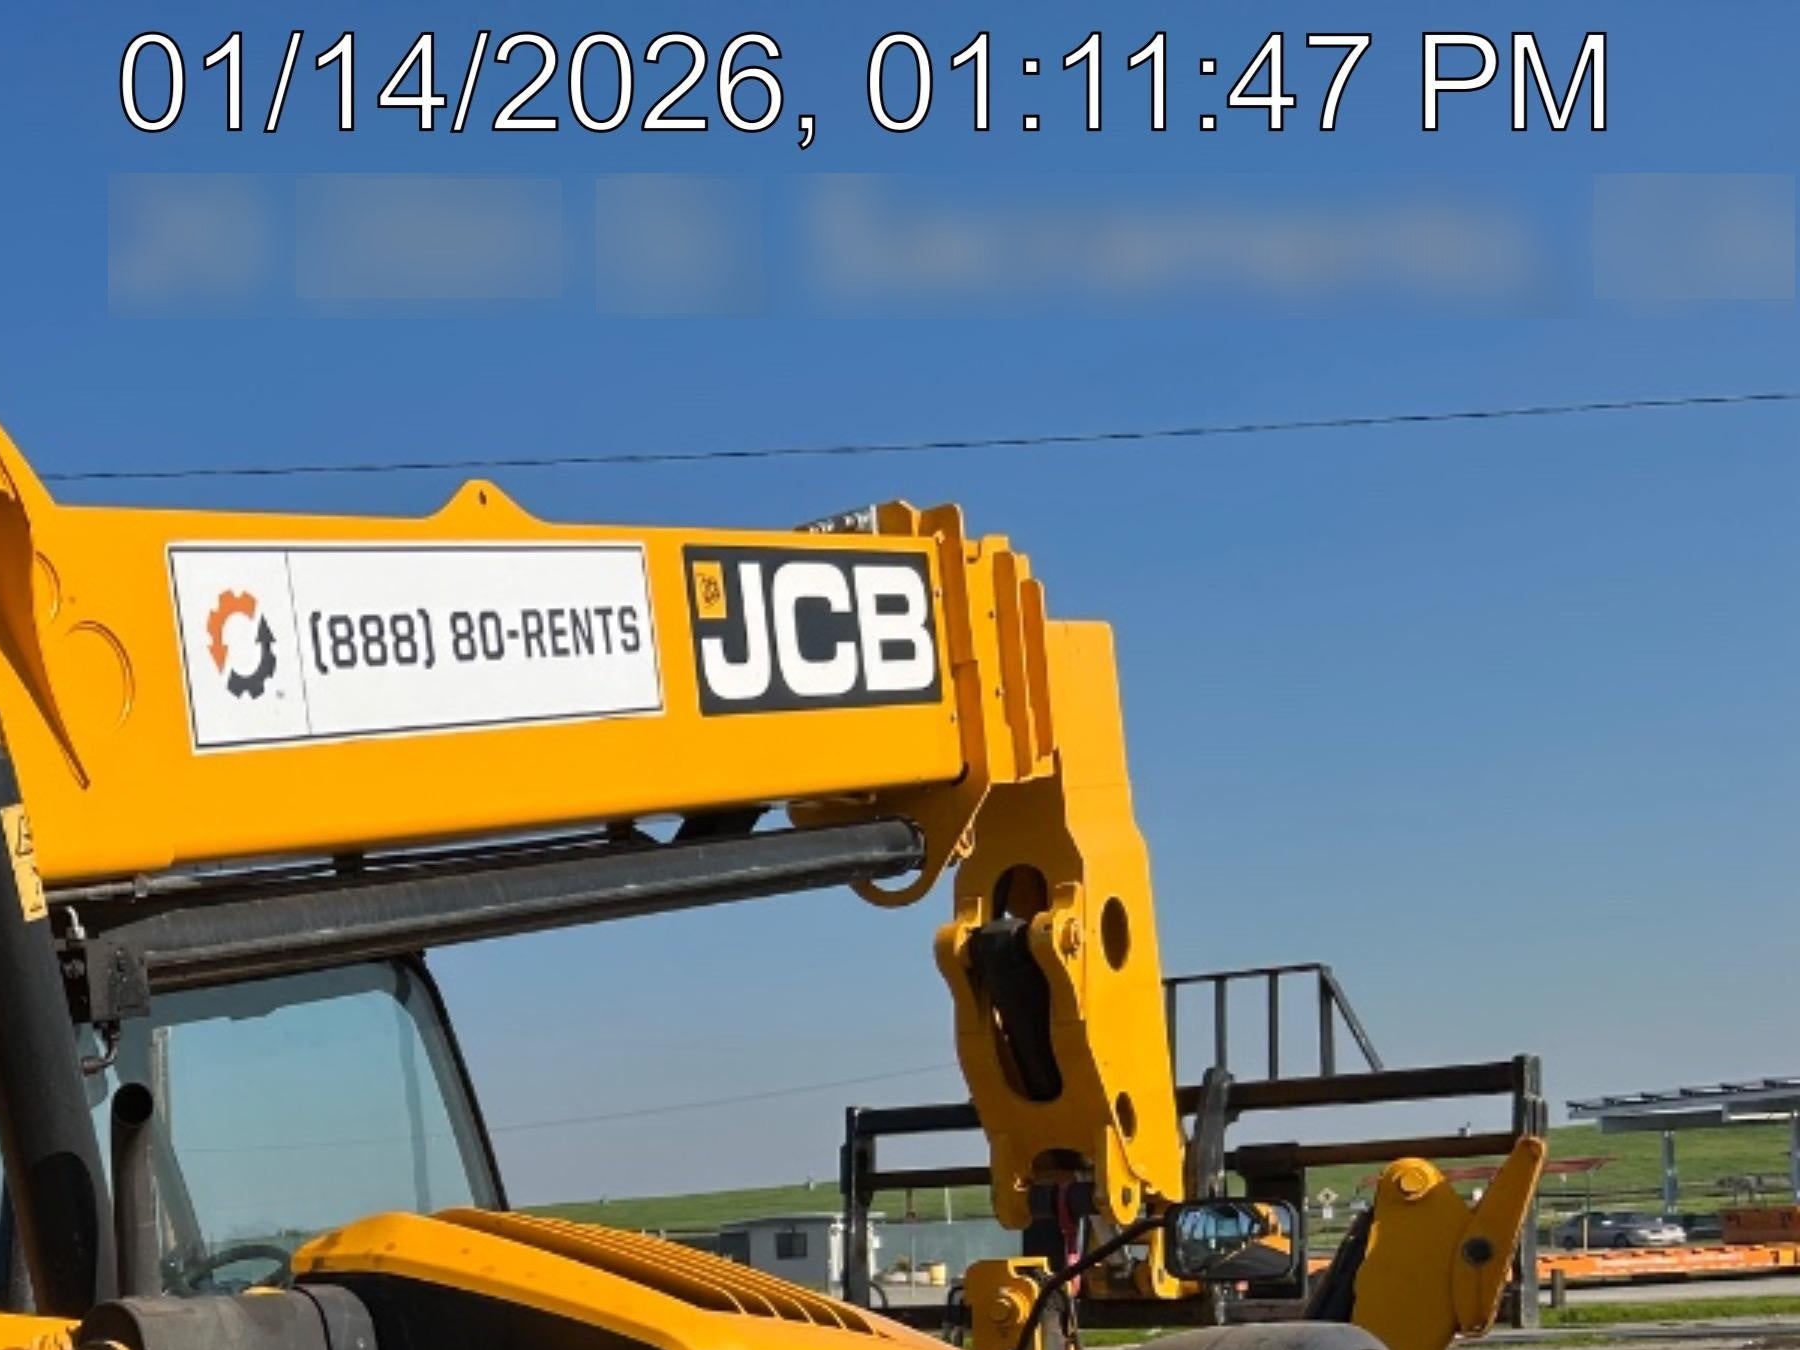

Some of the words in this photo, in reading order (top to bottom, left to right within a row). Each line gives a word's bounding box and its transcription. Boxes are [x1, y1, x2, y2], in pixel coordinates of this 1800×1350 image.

[309, 608, 435, 674] (888)
[449, 606, 641, 662] 80-RENTS
[700, 561, 936, 700] JCB
